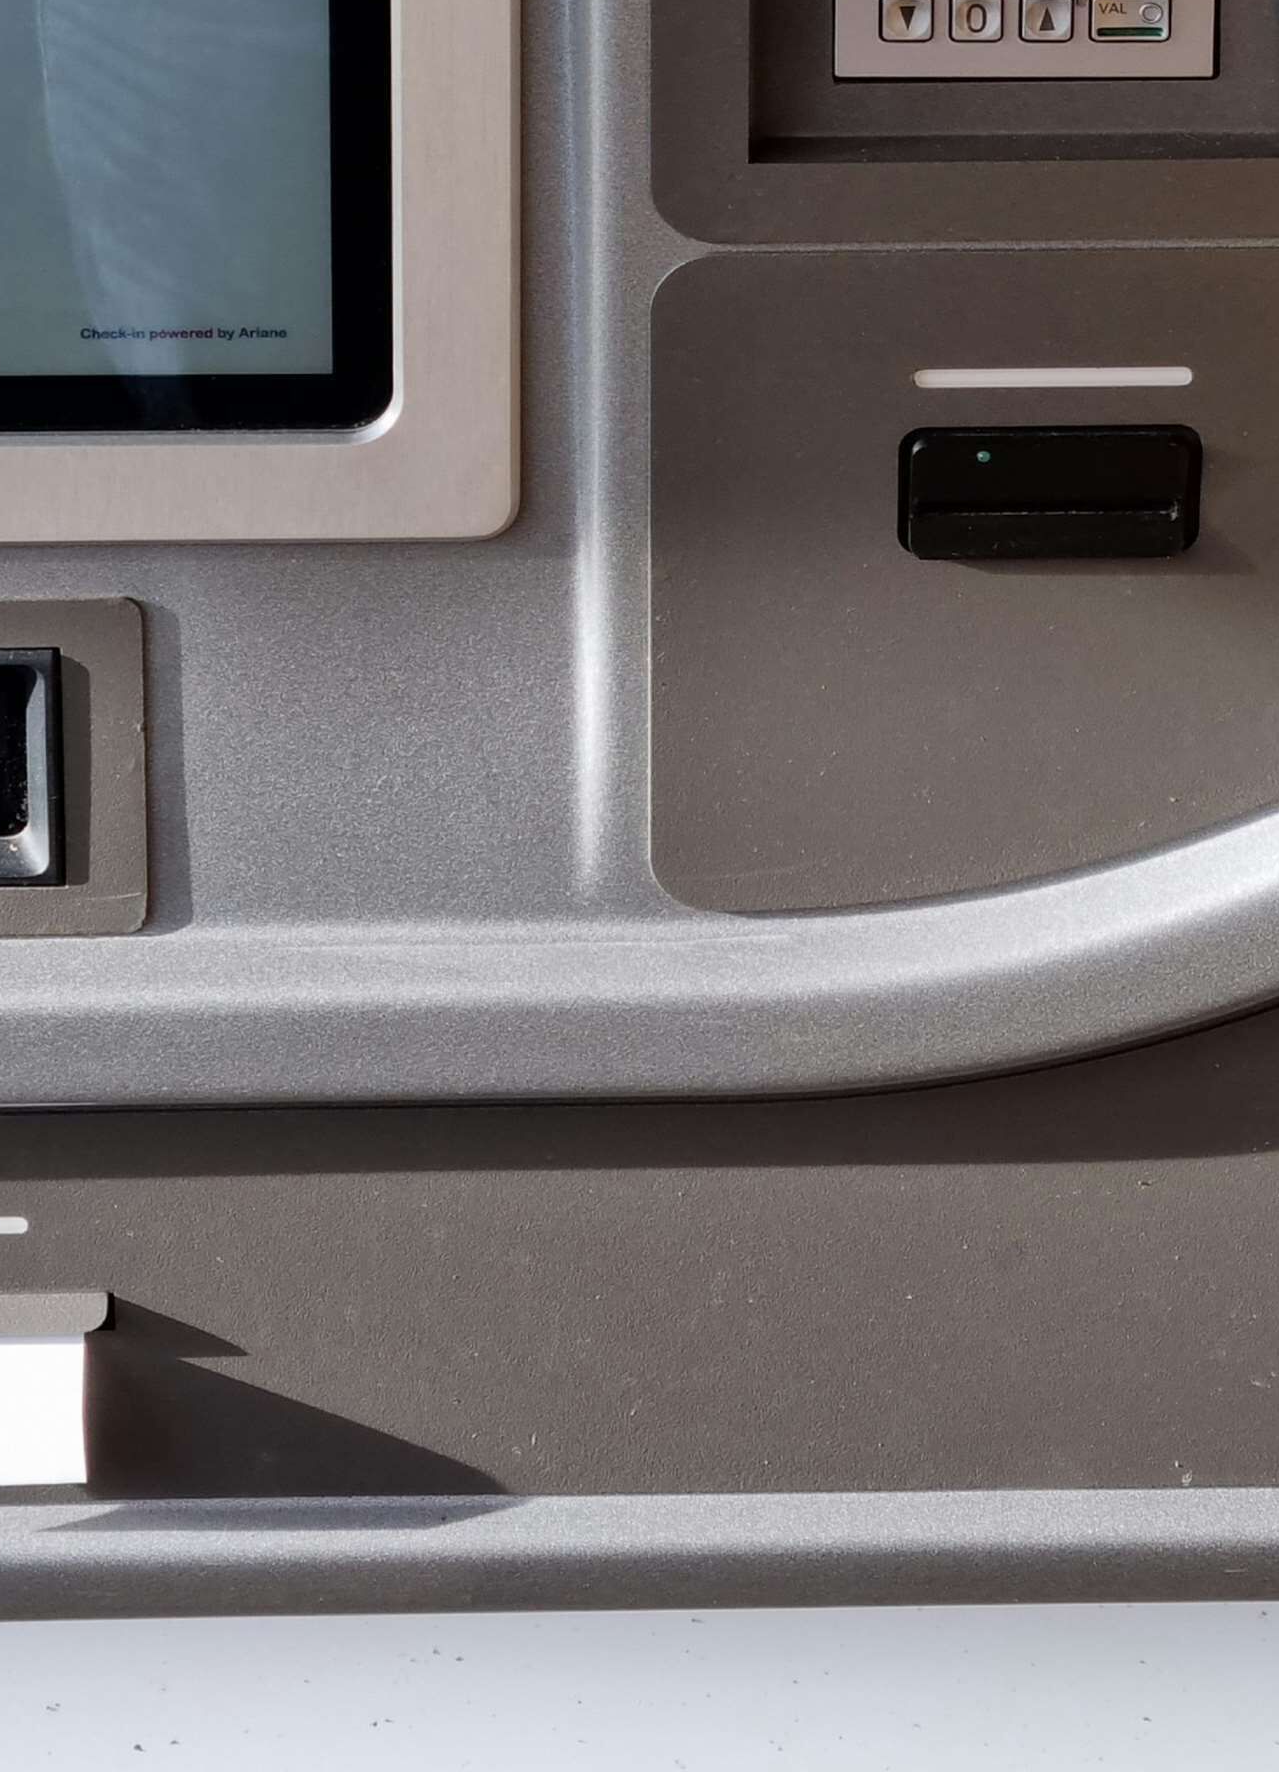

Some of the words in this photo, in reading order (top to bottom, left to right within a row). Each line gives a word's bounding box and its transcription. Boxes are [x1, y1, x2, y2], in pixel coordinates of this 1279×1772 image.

[1098, 3, 1128, 15] VAL
[966, 3, 987, 33] 0
[80, 327, 145, 340] Check-in
[149, 327, 214, 341] powered
[217, 327, 234, 340] by
[238, 327, 288, 339] Ariane
